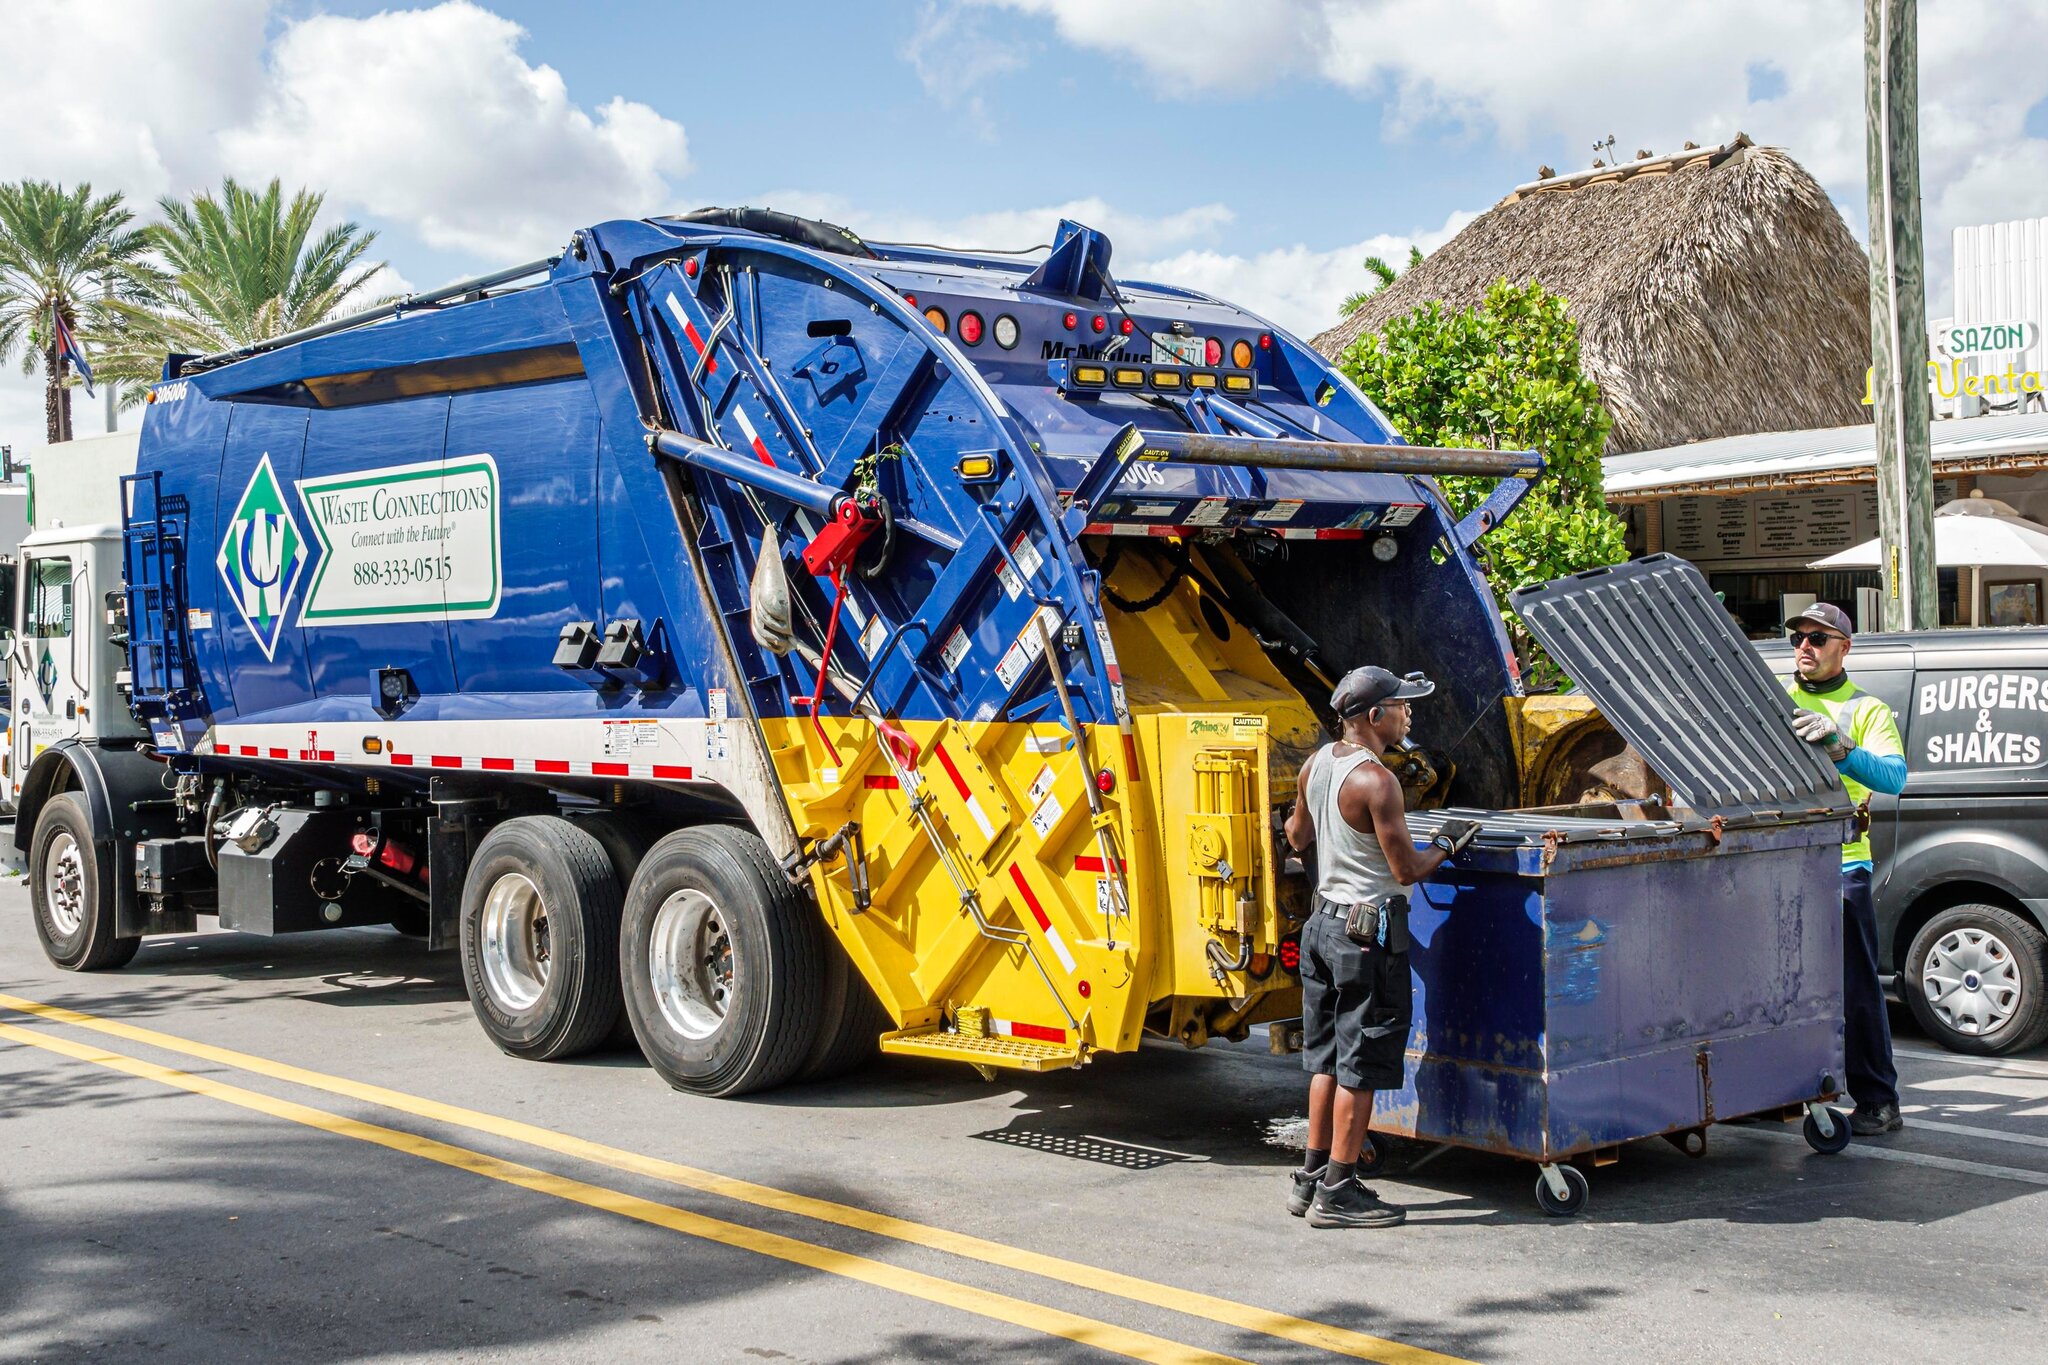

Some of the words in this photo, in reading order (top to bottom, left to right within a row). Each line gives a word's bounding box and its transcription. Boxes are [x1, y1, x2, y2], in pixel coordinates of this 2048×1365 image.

[1927, 358, 2045, 399] Venta
[1116, 428, 1136, 455] CAUTION
[1143, 449, 1170, 457] CAUTION
[352, 530, 385, 548] Connect
[387, 527, 404, 545] with
[406, 525, 420, 543] the
[353, 555, 451, 586] 888-333-0515
[1234, 718, 1262, 726] CAUTION
[1976, 708, 1993, 733] &
[1927, 732, 2041, 764] SHAKES
